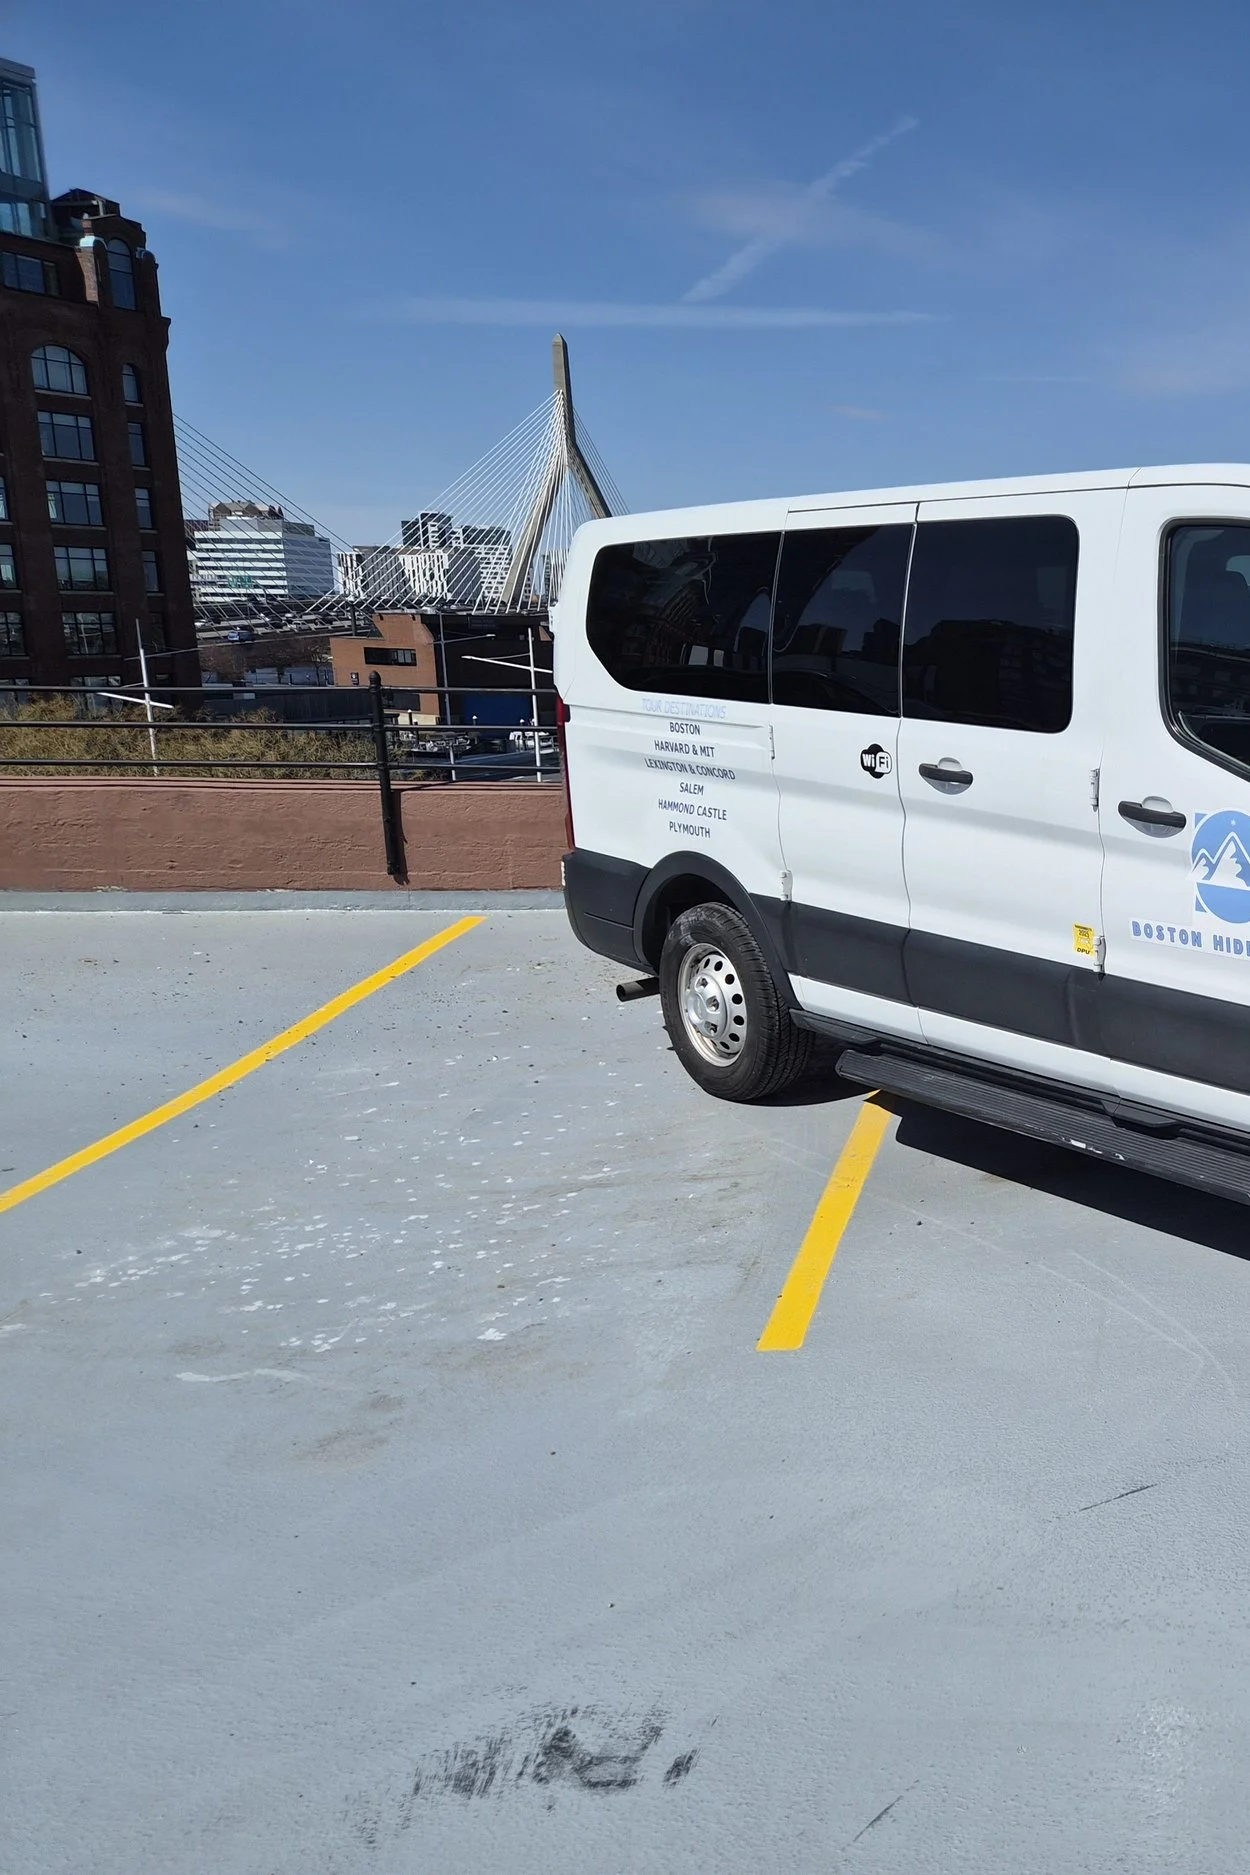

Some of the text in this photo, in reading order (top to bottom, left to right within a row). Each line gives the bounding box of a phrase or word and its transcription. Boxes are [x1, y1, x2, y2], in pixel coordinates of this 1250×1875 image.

[642, 698, 727, 719] TOUR DESTINATIONS
[670, 721, 701, 735] BOSTON
[654, 740, 715, 758] HARVARD & MIT
[644, 758, 736, 780] LEXINGTON & CONCORD
[679, 782, 704, 796] SALEM
[658, 798, 727, 821] HAMMOND CASTLE
[669, 821, 711, 838] PLYMOUTH
[1132, 920, 1202, 948] BOSTON
[1076, 947, 1090, 955] DPU
